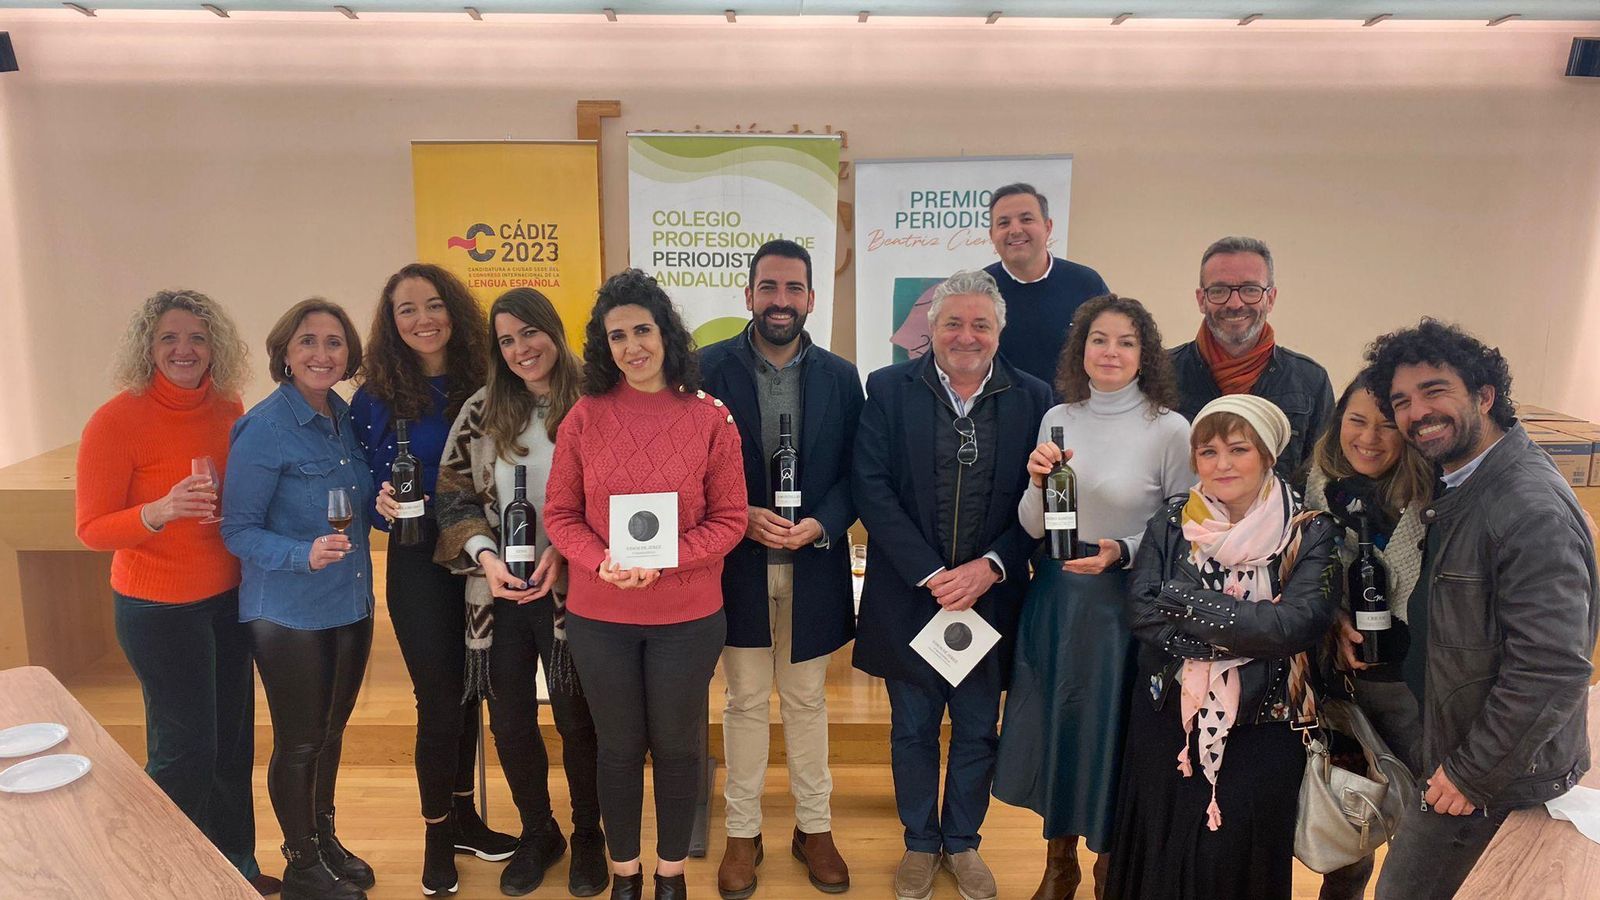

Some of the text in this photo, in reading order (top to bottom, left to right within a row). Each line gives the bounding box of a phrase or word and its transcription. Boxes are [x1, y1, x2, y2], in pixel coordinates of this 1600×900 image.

[910, 190, 992, 209] PREMIO
[652, 210, 741, 228] COLEGIO
[895, 211, 991, 229] PERIODIS
[500, 218, 559, 240] CÁDIZ
[794, 236, 815, 249] DE
[867, 229, 940, 252] Beatriz
[501, 241, 559, 262] 2023
[653, 251, 755, 269] PERIODIST
[468, 277, 560, 288] LENGUA ESPAÑOLA
[655, 271, 748, 288] ANDALUC
